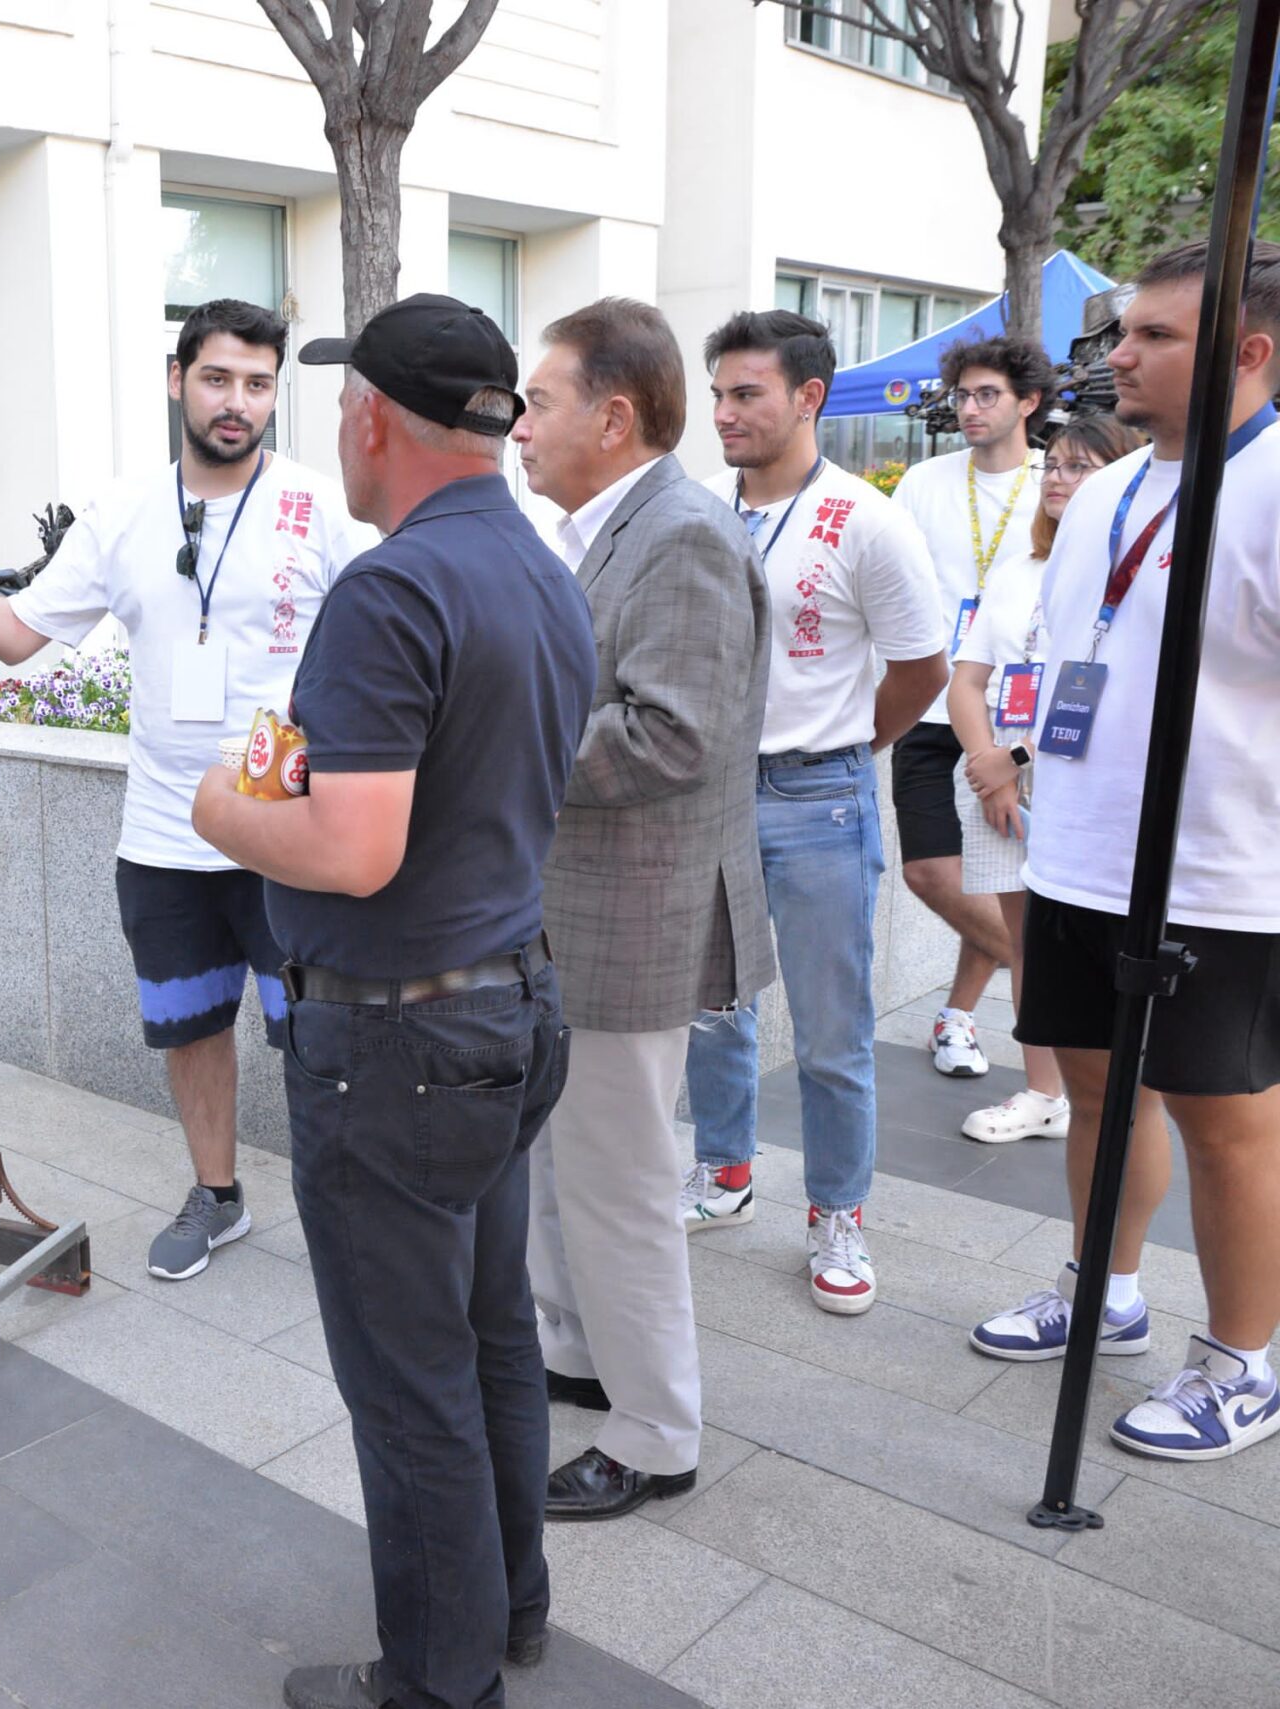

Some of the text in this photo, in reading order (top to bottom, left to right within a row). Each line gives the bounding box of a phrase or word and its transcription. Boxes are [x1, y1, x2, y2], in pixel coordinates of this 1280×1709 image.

[282, 490, 313, 501] TEDU
[823, 498, 856, 510] TEDU
[278, 499, 312, 522] TE
[816, 505, 850, 530] TE
[275, 518, 308, 539] AM
[808, 525, 840, 549] AM
[1051, 726, 1081, 741] TEDU
